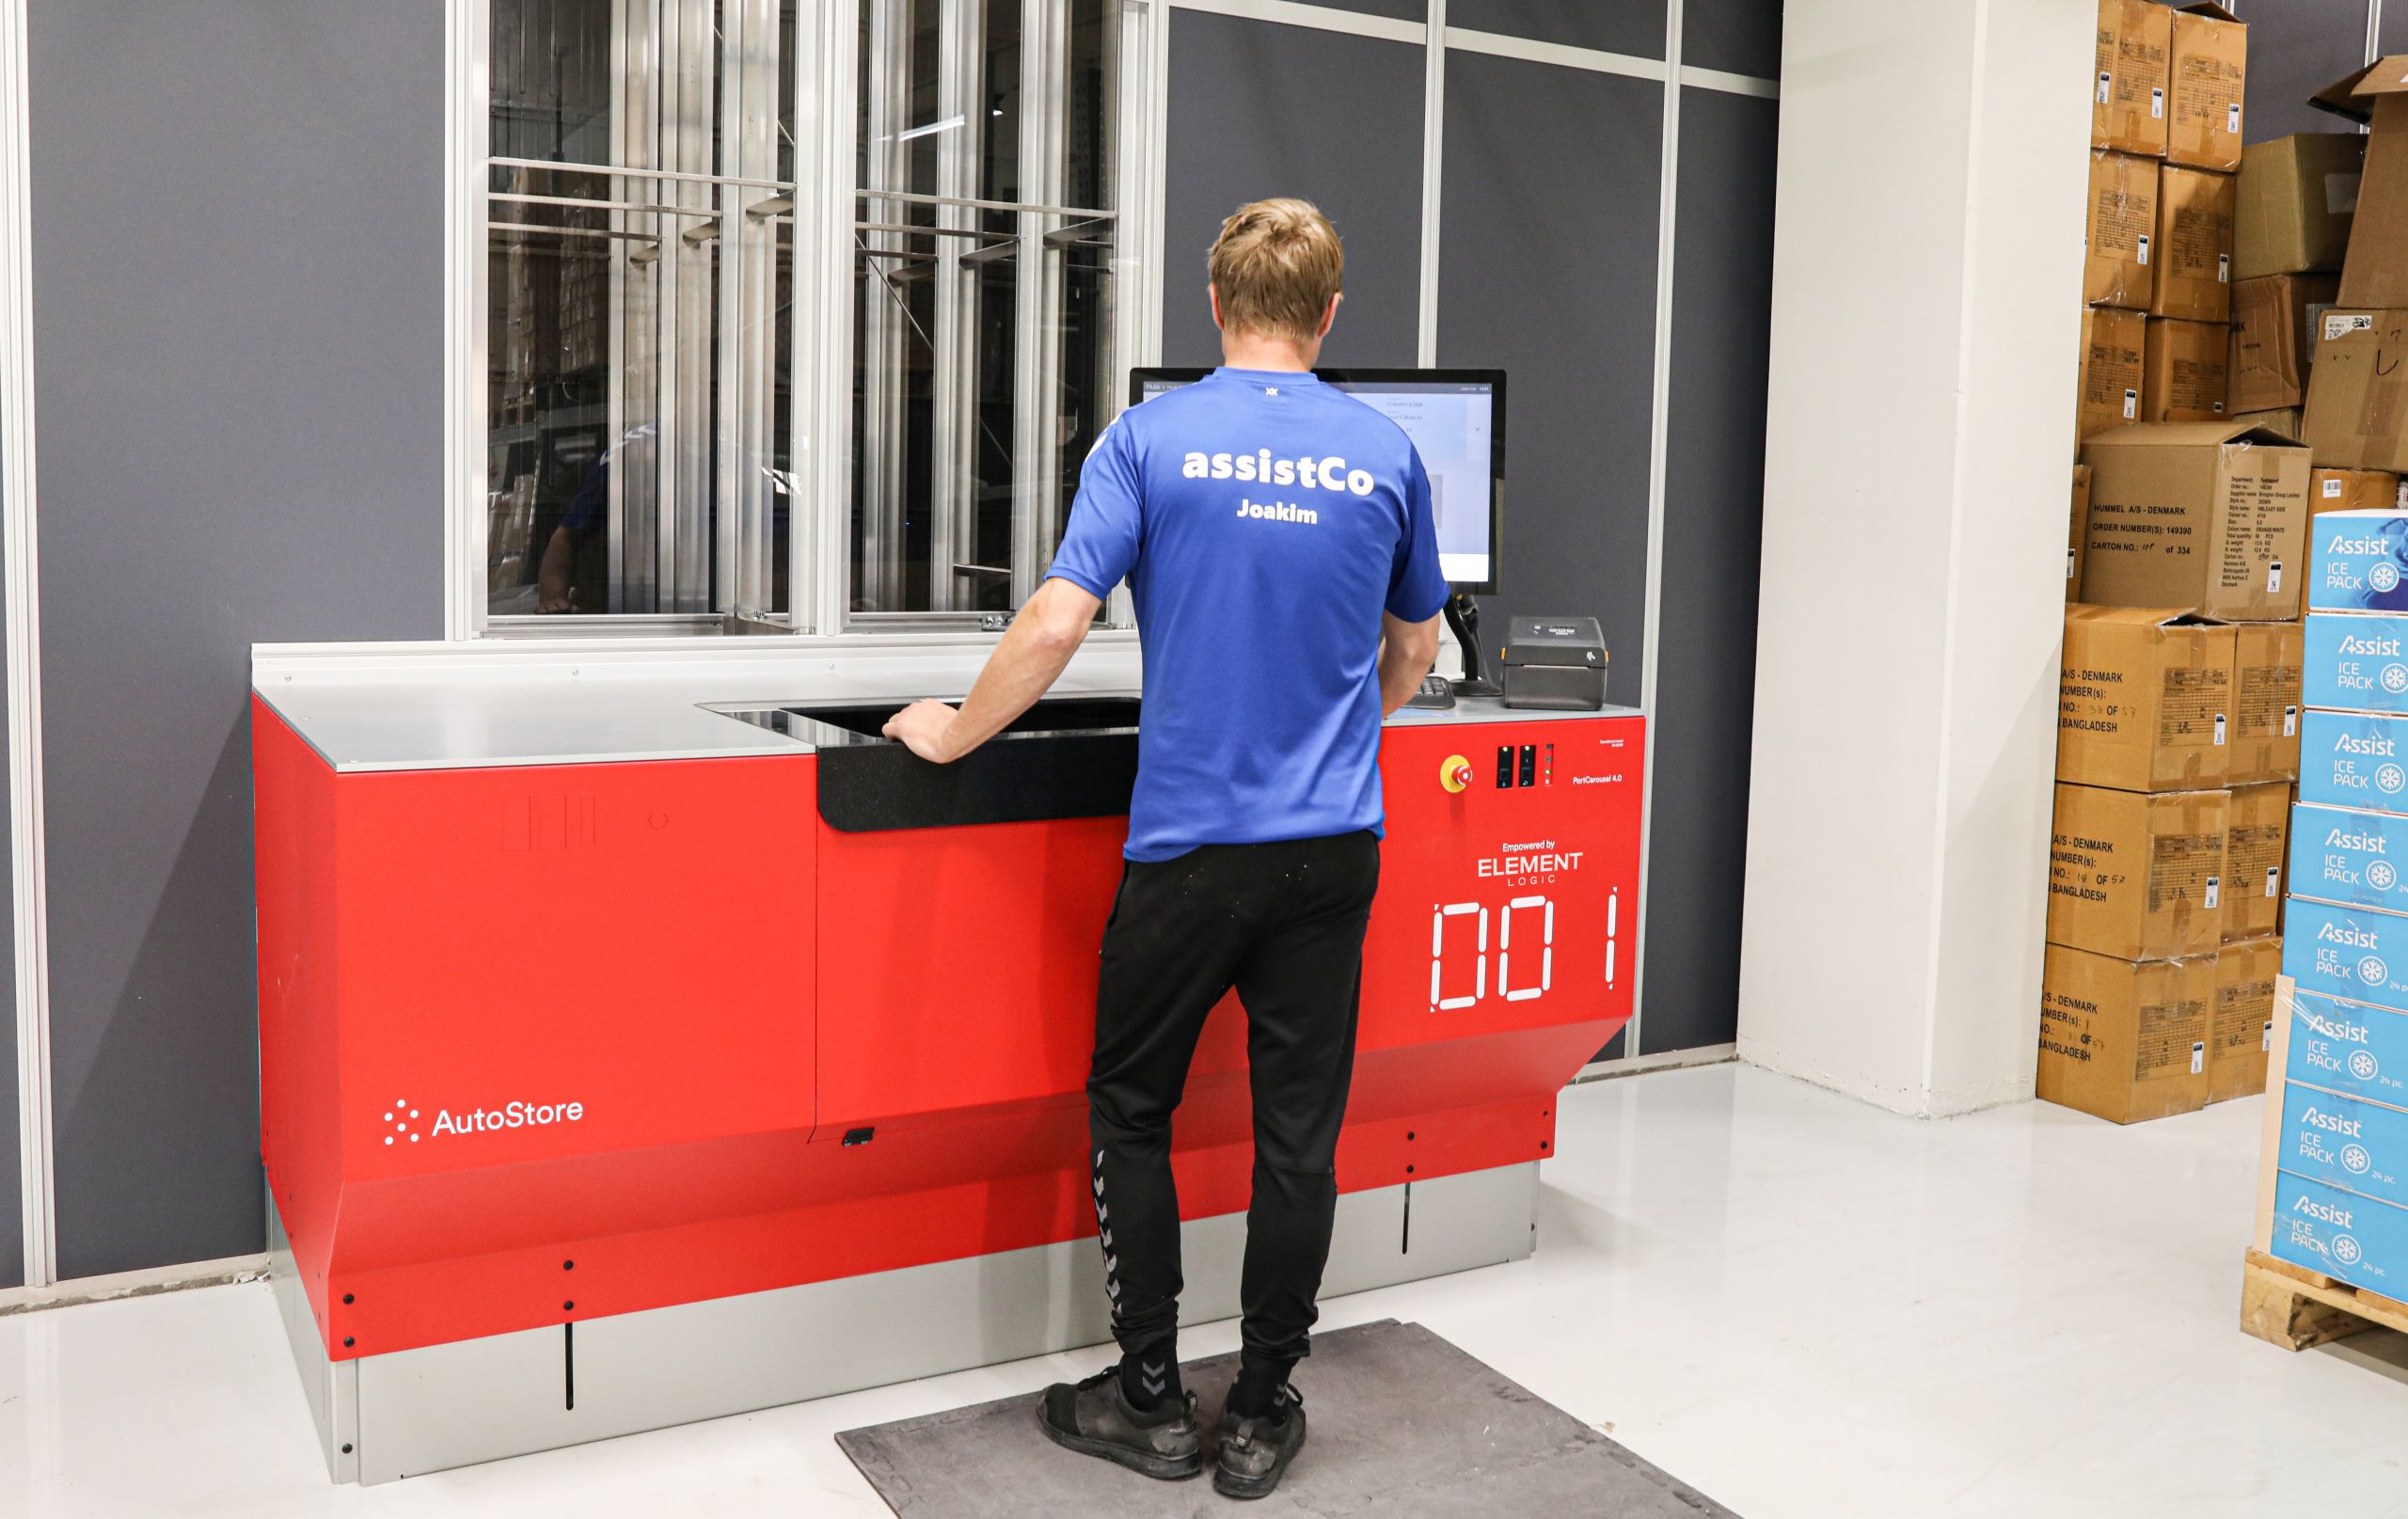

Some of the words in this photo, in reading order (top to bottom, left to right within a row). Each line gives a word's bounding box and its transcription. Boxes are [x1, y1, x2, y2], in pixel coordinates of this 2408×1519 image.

[1182, 448, 1374, 497] assistCo
[1237, 498, 1317, 525] Joakim
[2094, 504, 2125, 514] HUMMEL
[2147, 506, 2186, 515] DENMARK
[2093, 523, 2118, 532] ORDER
[2120, 525, 2163, 535] NUMBER(S):
[2167, 527, 2192, 535] 149390
[2092, 542, 2122, 551] CARTON
[2124, 544, 2139, 552] NO.:
[2327, 534, 2389, 555] Assist
[2327, 562, 2348, 575] ICE
[2327, 576, 2363, 589] PACK
[2338, 635, 2400, 657] Assist
[2062, 670, 2075, 679] A/S
[2083, 670, 2122, 683] DENMARK
[2338, 662, 2360, 675] ICE
[2338, 675, 2374, 690] PACK
[2064, 702, 2080, 713] NO.:
[2107, 705, 2118, 716] OF
[2062, 718, 2117, 733] BANGLADESH
[2335, 734, 2395, 756] Assist
[2335, 760, 2355, 773] ICE
[2334, 773, 2368, 789] PACK
[1502, 840, 1545, 853] Empowered
[1546, 839, 1556, 850] by
[2053, 835, 2067, 846] A/S
[2073, 837, 2113, 853] DENMARK
[2325, 828, 2385, 854] Assist
[1478, 852, 1584, 877] ELEMENT
[2325, 854, 2346, 869] ICE
[1507, 875, 1556, 887] LOGIC
[2054, 867, 2069, 879] NO.:
[2096, 875, 2108, 885] OF
[2324, 867, 2359, 884] PACK
[2052, 883, 2107, 902] BANGLADESH
[2318, 922, 2378, 950] Assist
[2318, 948, 2338, 963] ICE
[2316, 961, 2352, 978] PACK
[2389, 980, 2400, 989] 24
[2058, 995, 2098, 1014] DENMARK
[2308, 1015, 2368, 1044] Assist
[2081, 1033, 2092, 1044] OF
[2308, 1039, 2329, 1055] ICE
[2306, 1052, 2342, 1072] PACK
[2380, 1075, 2389, 1085] 24
[432, 1101, 583, 1136] AutoStore
[2301, 1106, 2362, 1139] Assist
[2301, 1131, 2321, 1147] ICE
[2299, 1144, 2335, 1164] PACK
[2372, 1170, 2383, 1180] 24
[2293, 1195, 2353, 1229] Assist
[2292, 1219, 2313, 1236] ICE
[2291, 1232, 2328, 1256] PACK
[2363, 1262, 2373, 1272] 24
